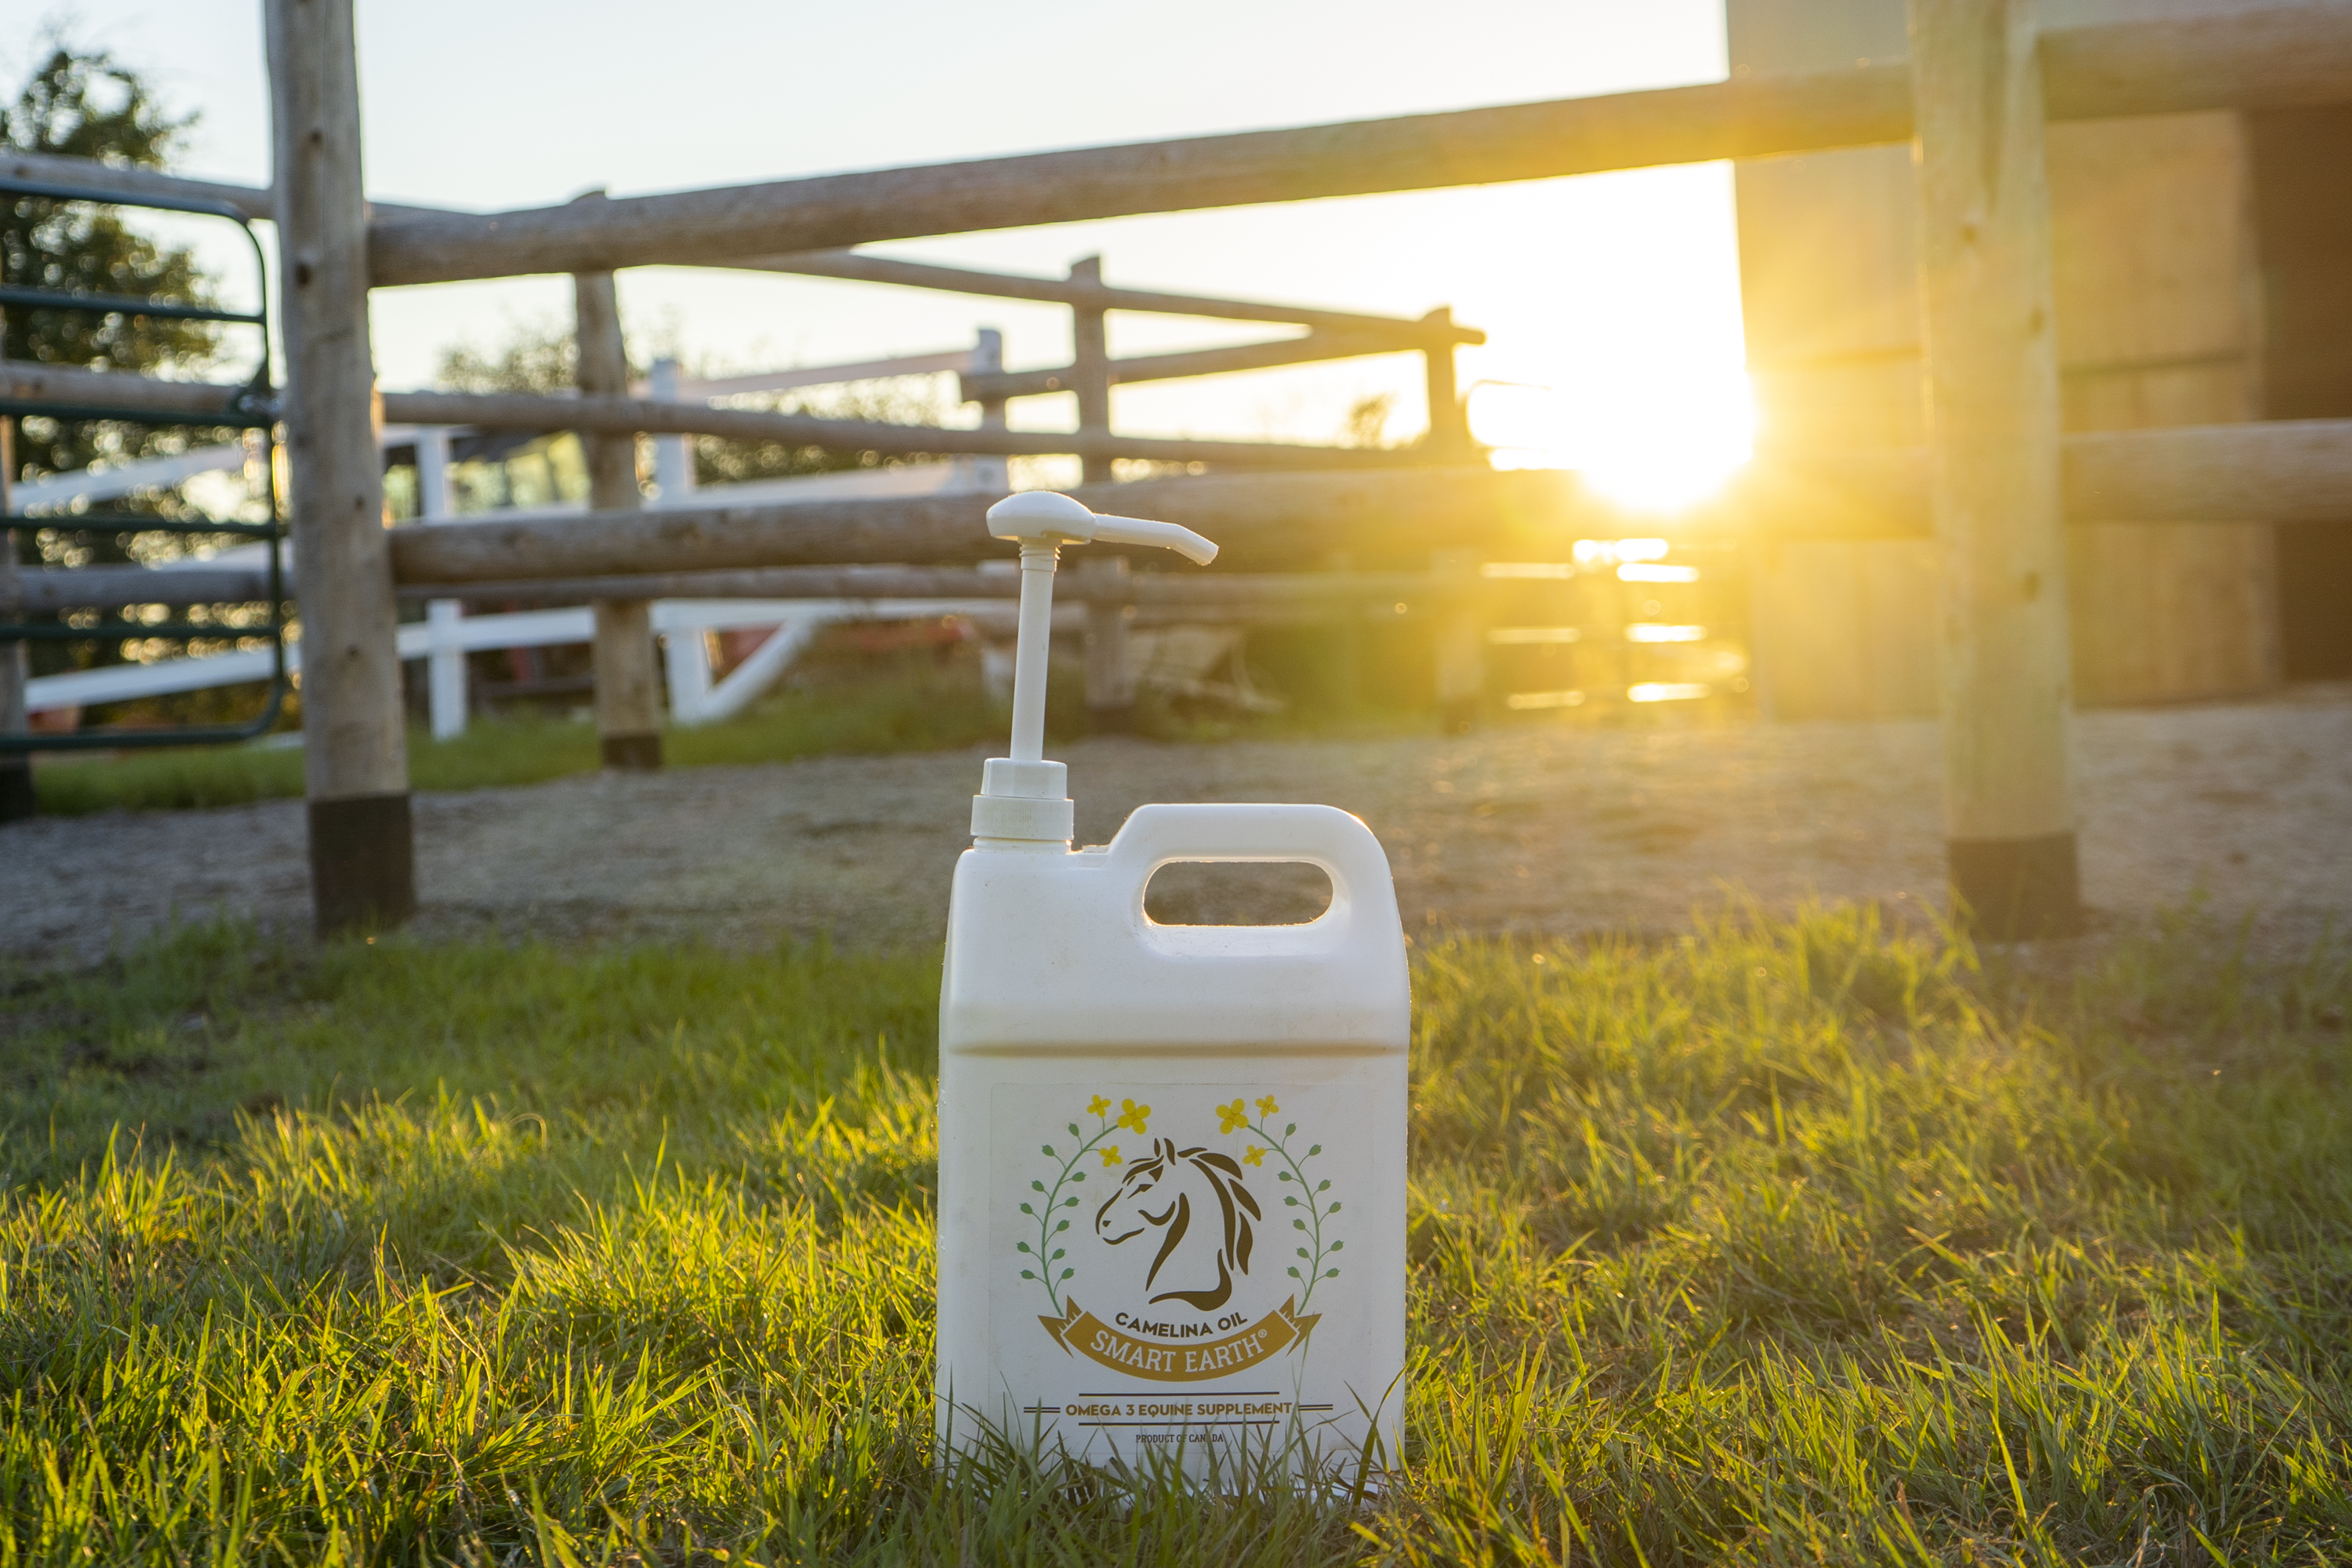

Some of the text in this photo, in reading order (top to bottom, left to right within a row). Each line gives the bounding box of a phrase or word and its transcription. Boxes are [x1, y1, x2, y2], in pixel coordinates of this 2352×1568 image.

[1116, 1312, 1248, 1337] CAMELINA OIL
[1091, 1330, 1176, 1373] SMART
[1065, 1402, 1293, 1417] OMEGA 3 EQUINE SUPPLEMENT
[1135, 1434, 1174, 1443] PRODUCT
[1189, 1434, 1224, 1443] CANDA
